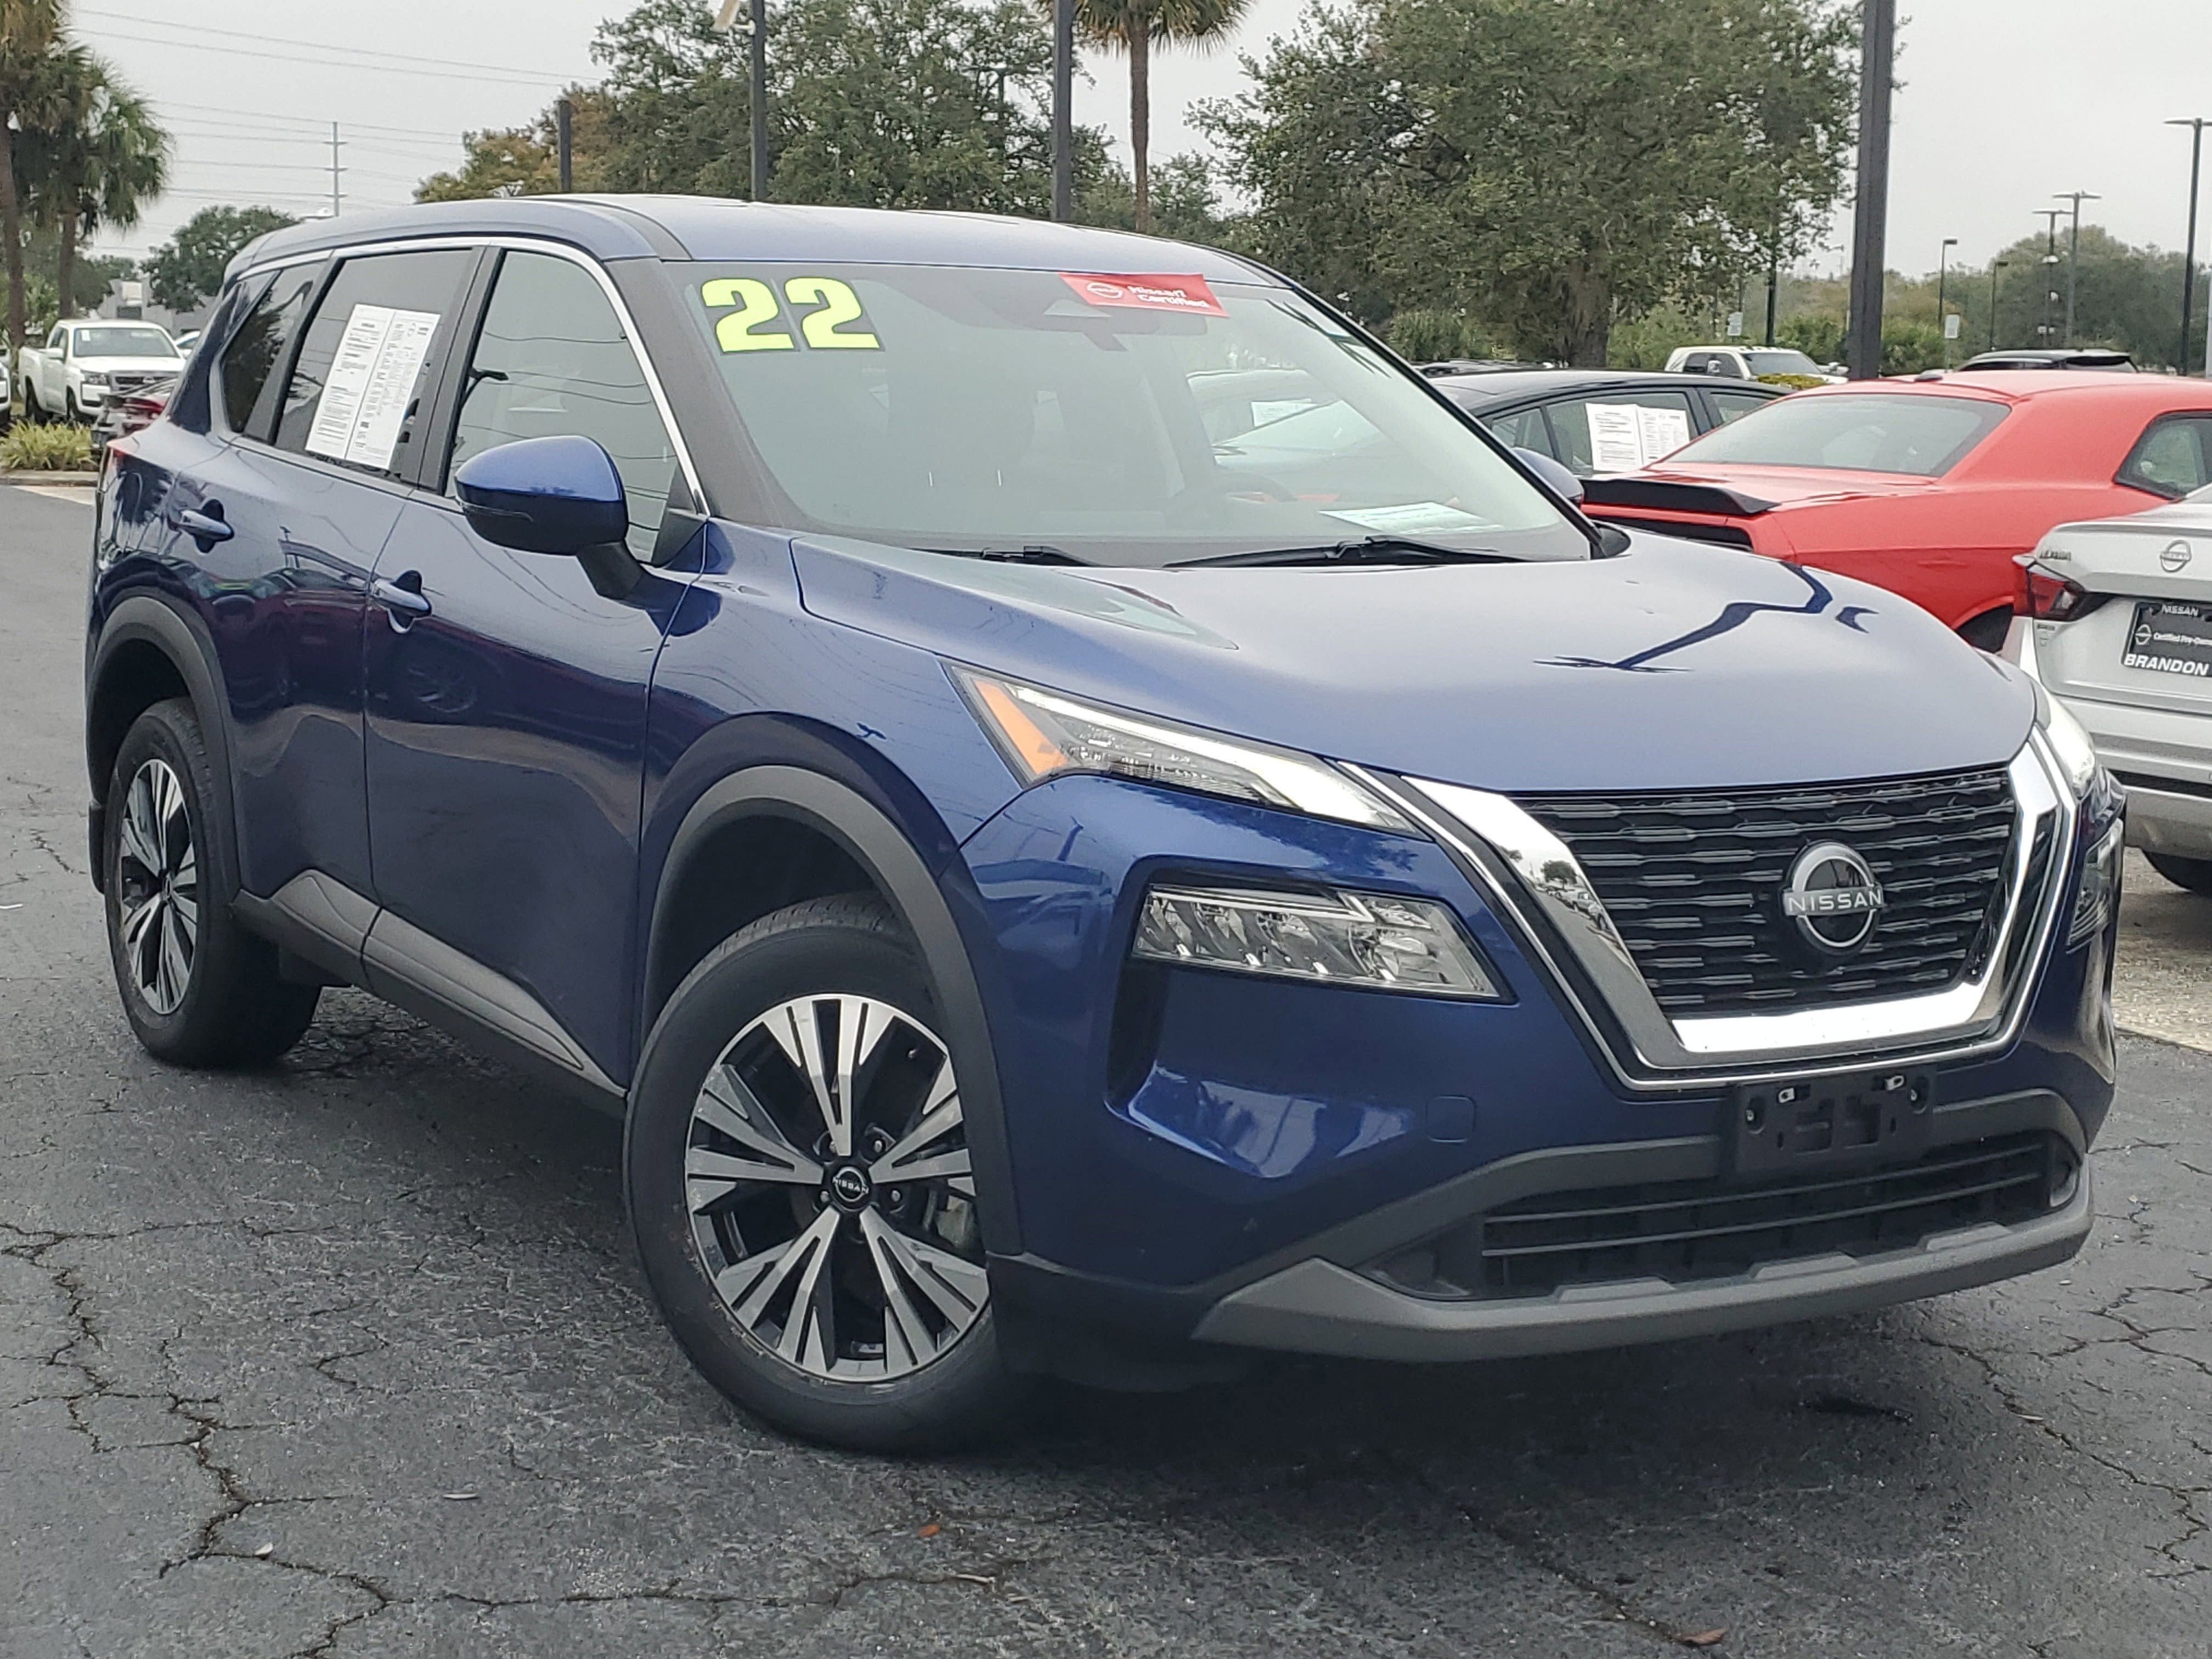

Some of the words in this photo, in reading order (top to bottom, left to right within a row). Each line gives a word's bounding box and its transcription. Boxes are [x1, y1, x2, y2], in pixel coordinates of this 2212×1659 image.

[701, 276, 881, 353] 22
[2162, 604, 2199, 617] NISSAN
[2124, 653, 2209, 676] BRANDON
[1787, 889, 1882, 912] NISSAN
